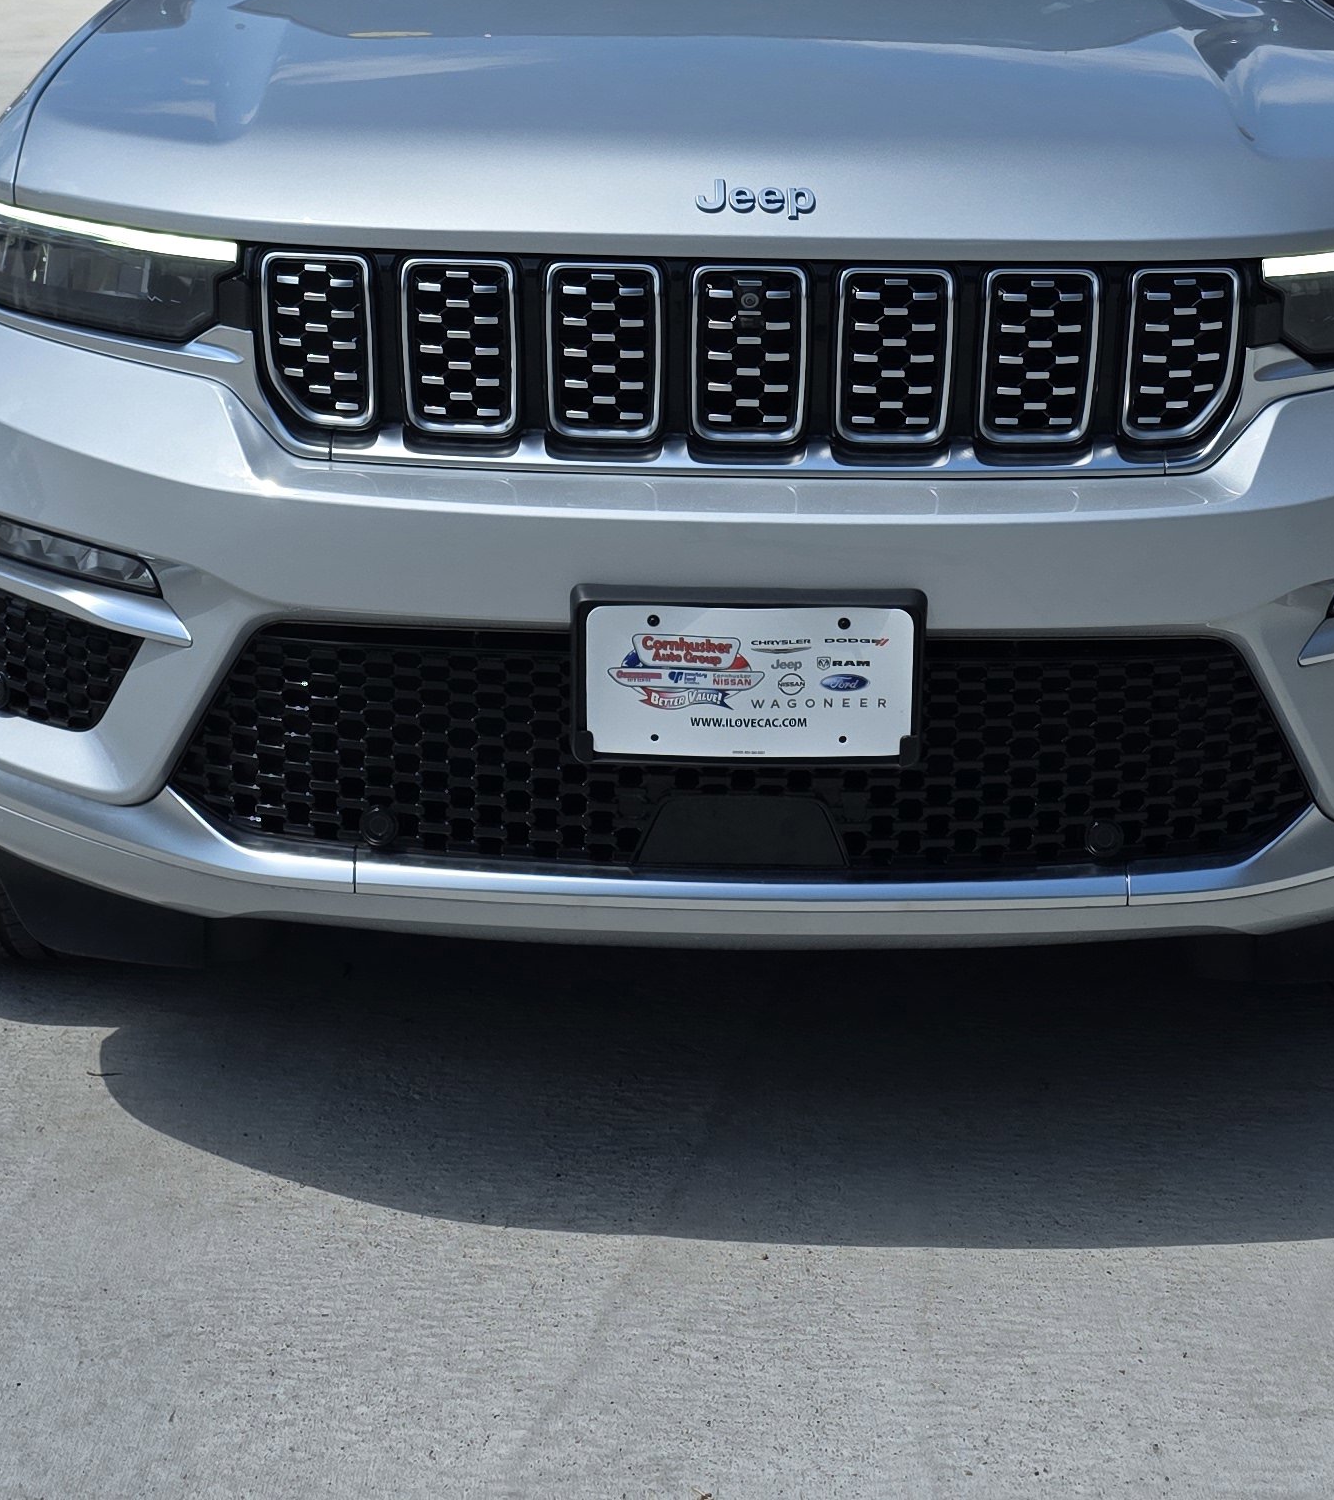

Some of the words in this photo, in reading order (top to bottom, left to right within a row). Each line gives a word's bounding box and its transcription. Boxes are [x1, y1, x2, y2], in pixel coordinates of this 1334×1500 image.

[695, 179, 816, 220] Jeep
[642, 635, 732, 654] Cornhusker
[750, 638, 811, 646] CHRYSLER
[652, 651, 682, 661] Auto
[683, 651, 722, 666] Group
[771, 659, 802, 671] Jeep
[829, 676, 859, 689] Ford
[651, 691, 686, 706] BETTER
[688, 688, 722, 705] VALUE!
[751, 698, 887, 709] WAGONEER
[690, 716, 808, 728] WWW.ILOVECAC.COM
